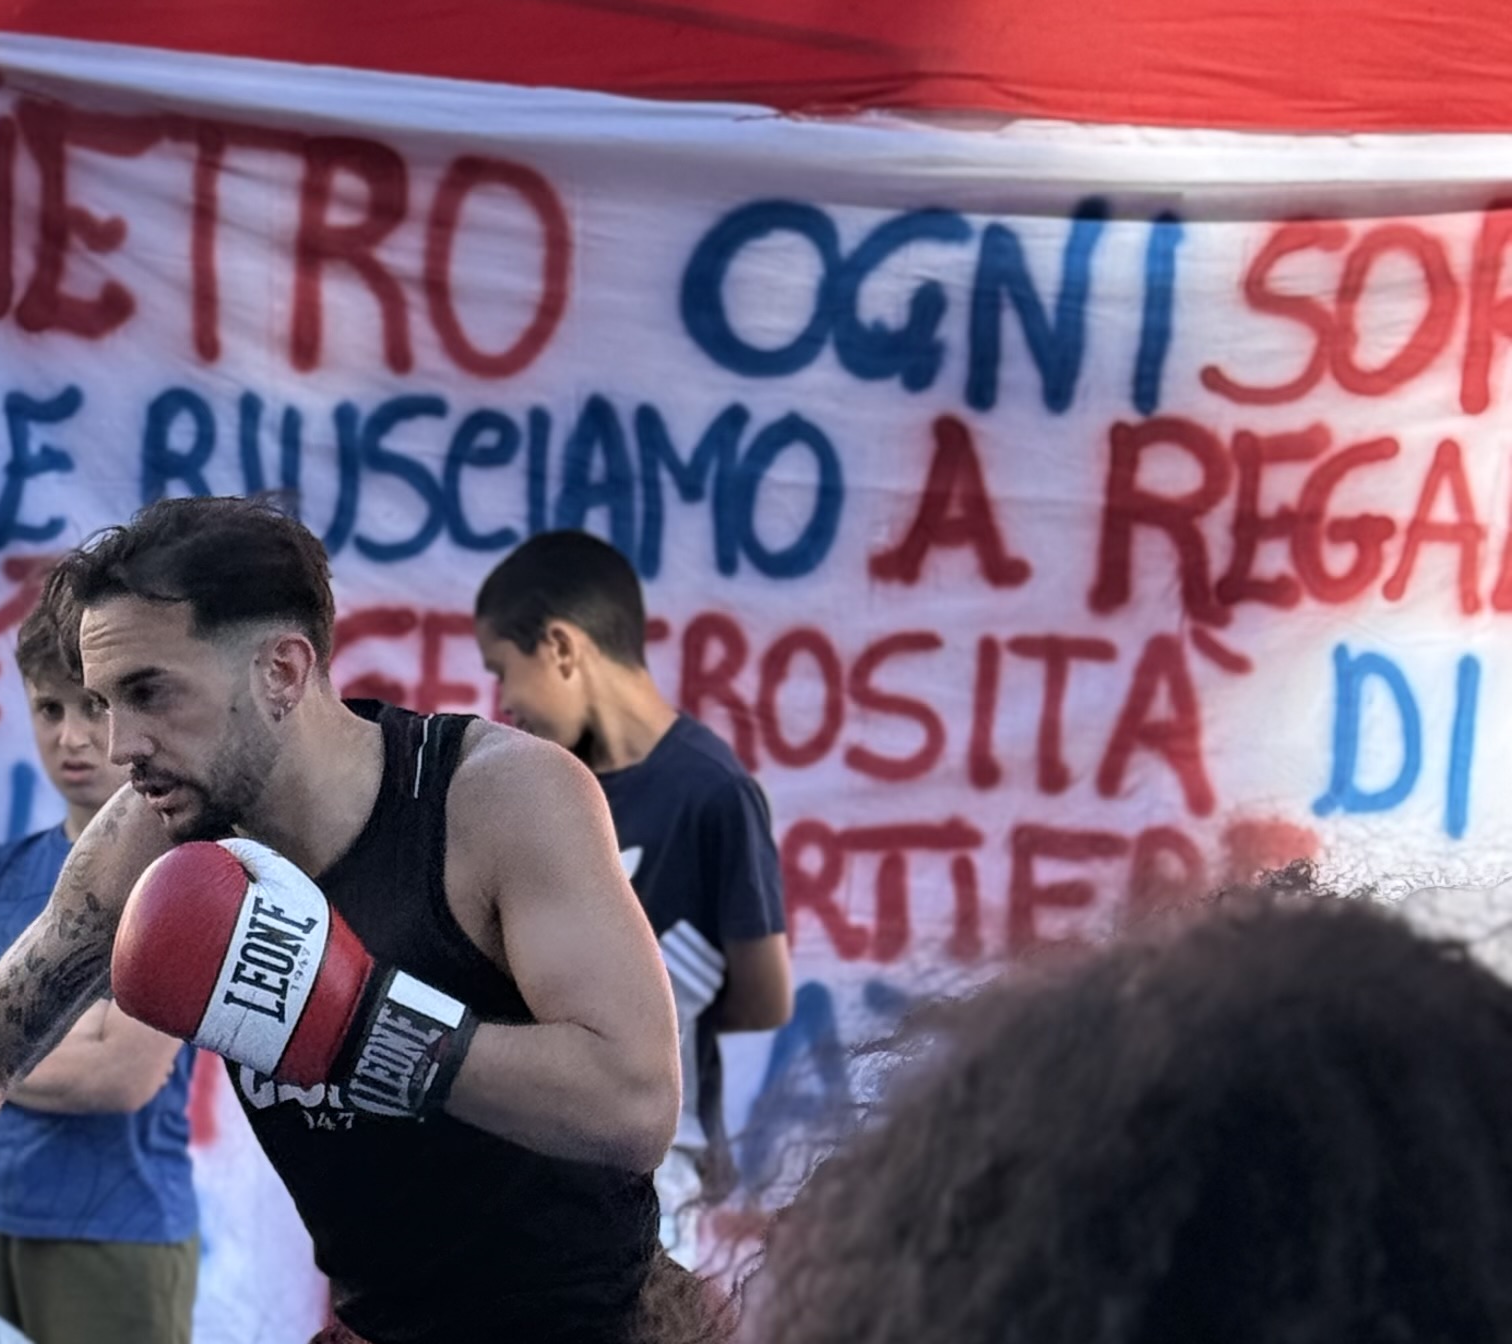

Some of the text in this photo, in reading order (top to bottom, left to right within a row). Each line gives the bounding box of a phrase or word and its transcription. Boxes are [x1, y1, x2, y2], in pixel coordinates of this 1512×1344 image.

[680, 197, 1183, 416] OGNI
[868, 414, 1032, 588] A
[1090, 416, 1512, 628] REGA
[1312, 641, 1483, 840] DI
[223, 896, 318, 1024] LEONE
[349, 1004, 443, 1109] LEONE
